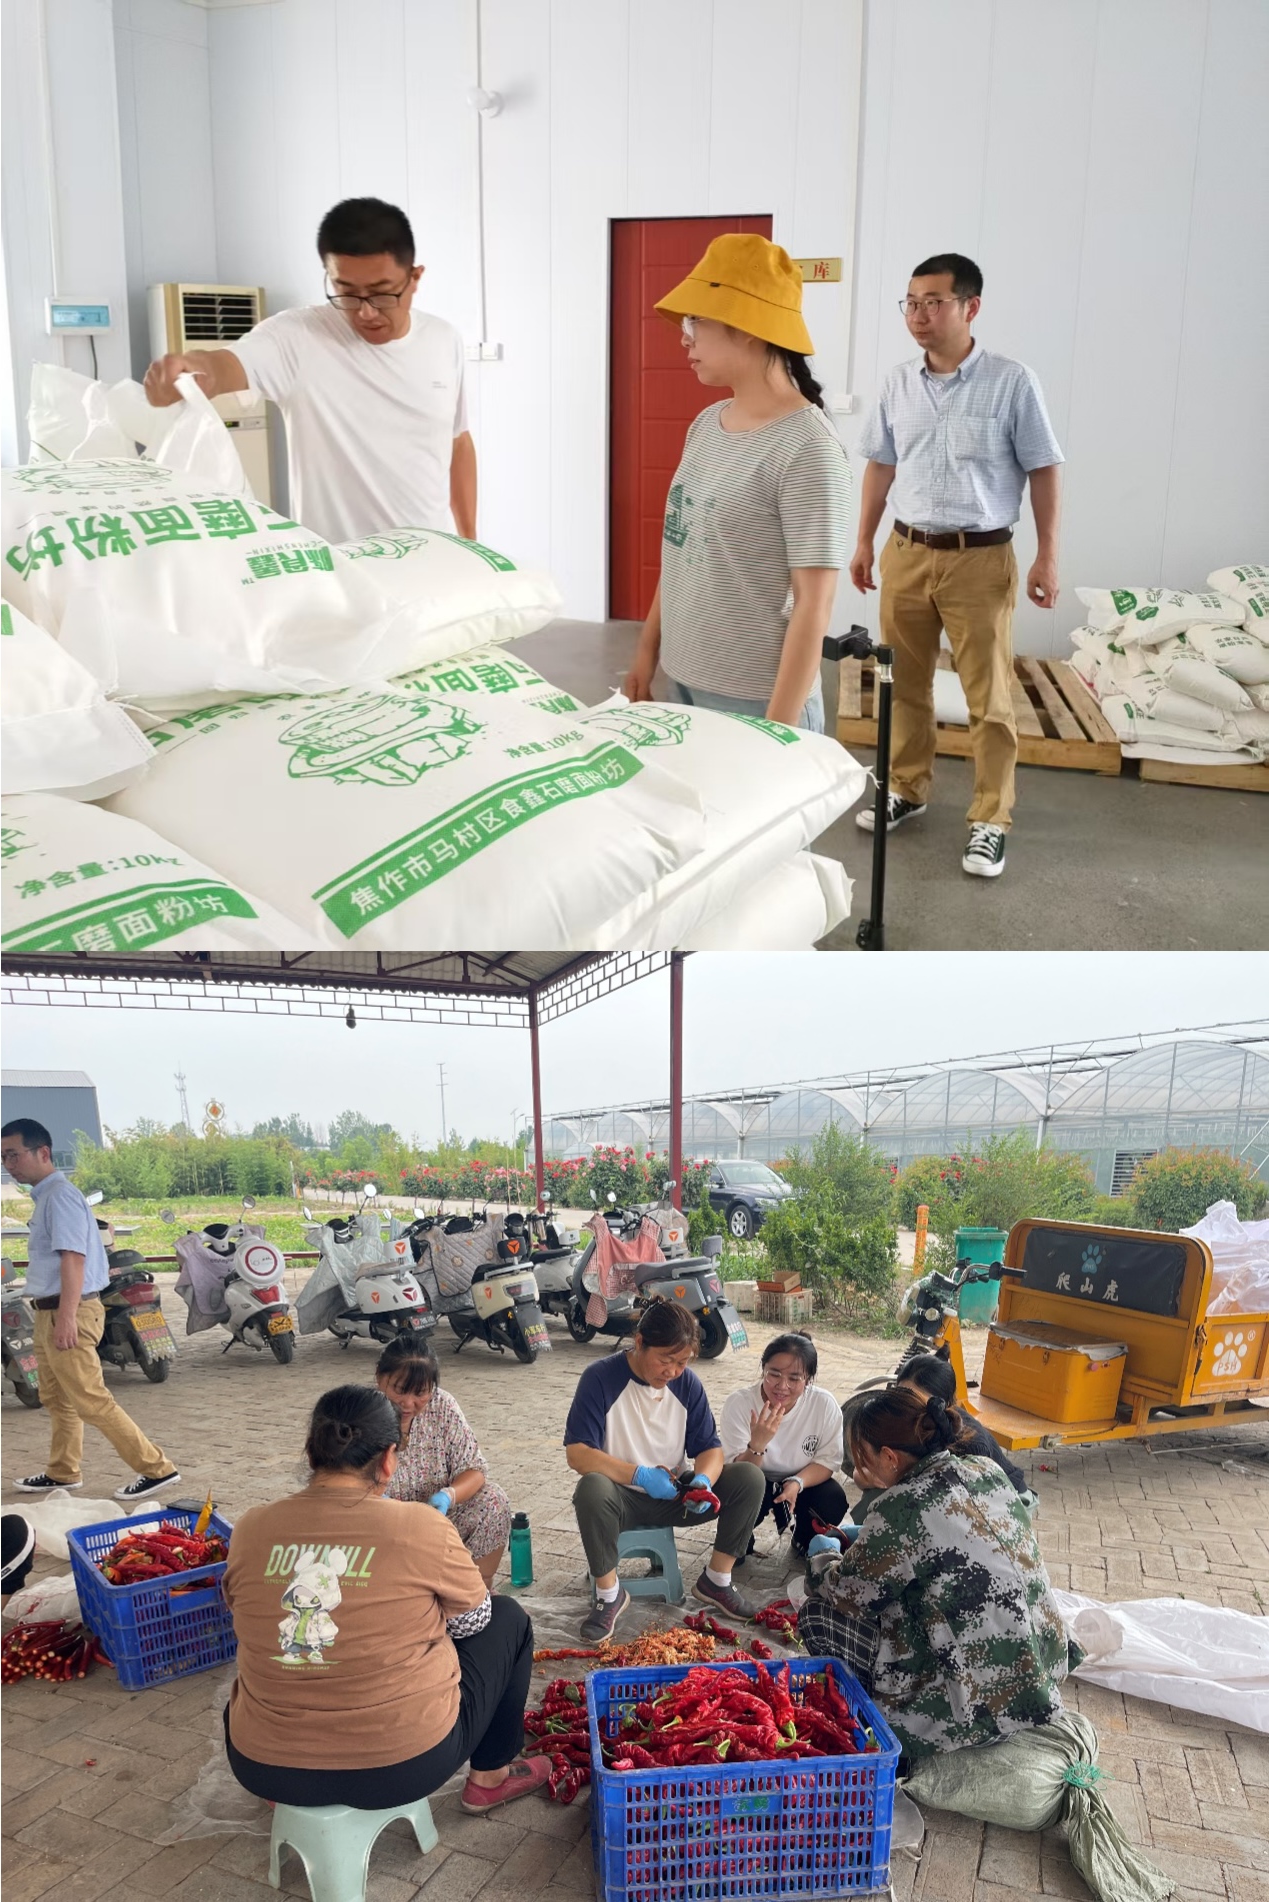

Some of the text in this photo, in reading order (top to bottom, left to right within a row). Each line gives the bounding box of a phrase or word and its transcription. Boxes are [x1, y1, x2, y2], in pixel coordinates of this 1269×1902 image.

[350, 757, 624, 915] 焦作市马村区食鑫石磨面粉坊
[36, 895, 229, 951] 磨面粉坊
[1056, 1271, 1119, 1301] 爬山虎
